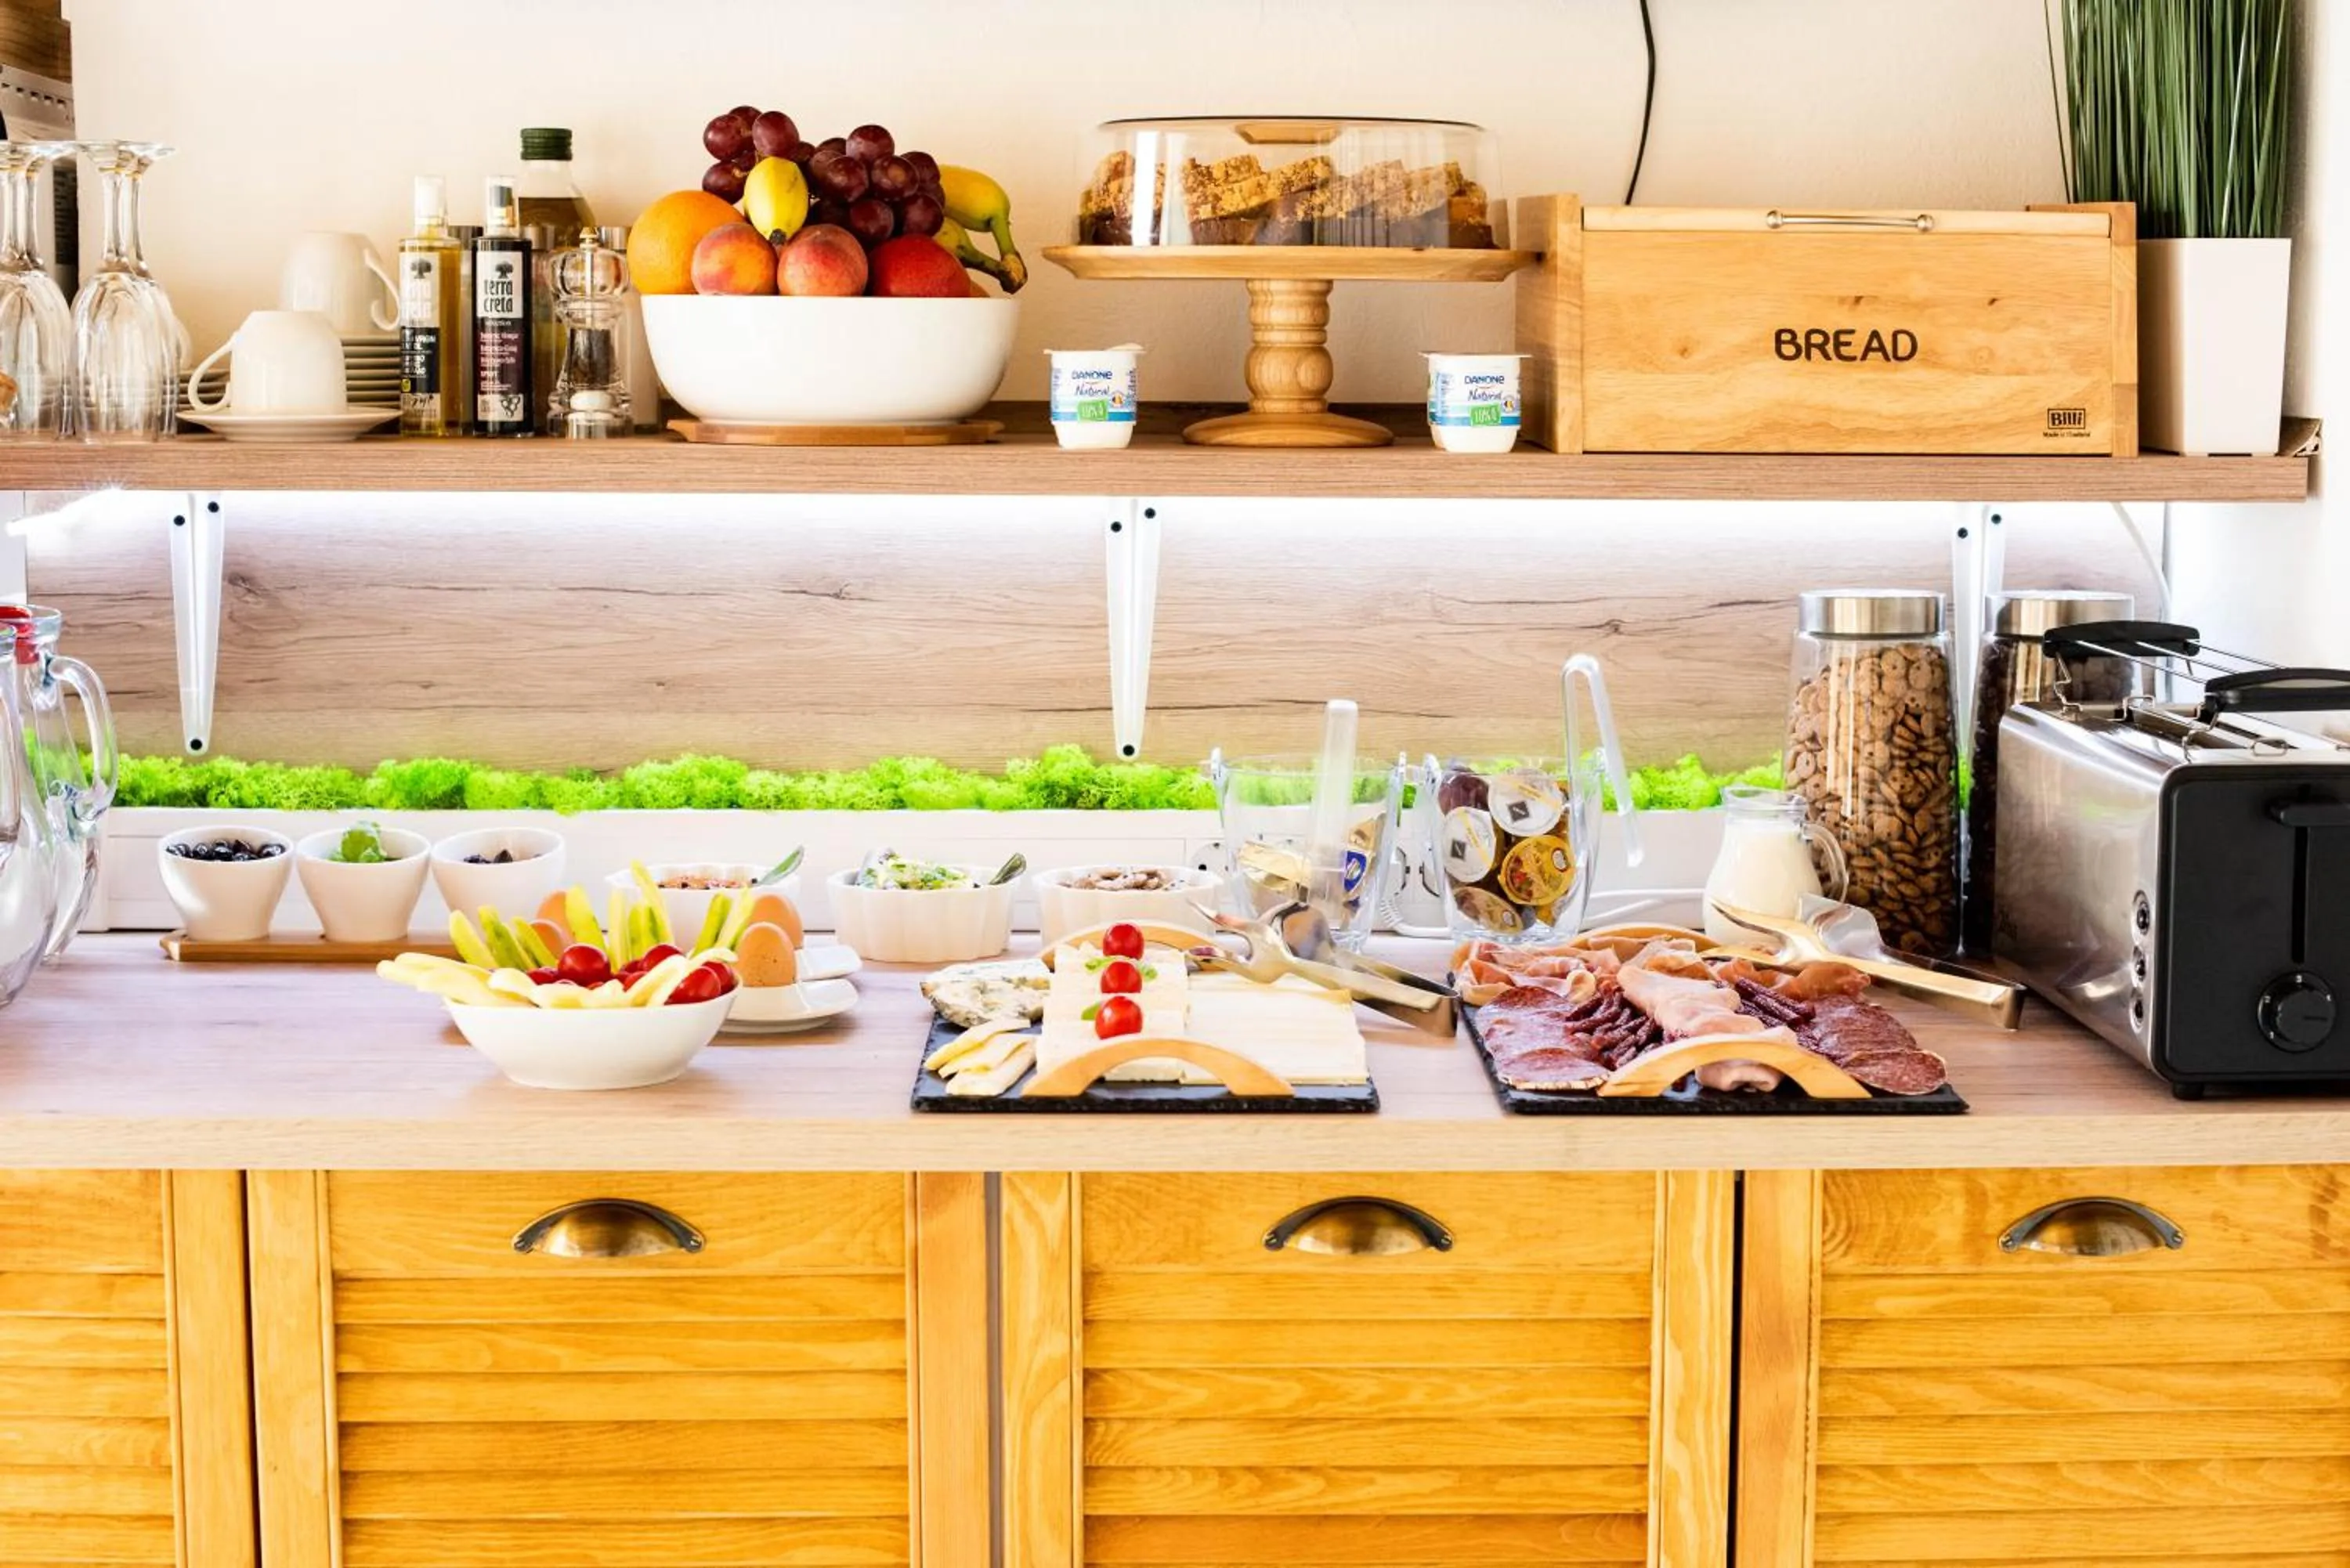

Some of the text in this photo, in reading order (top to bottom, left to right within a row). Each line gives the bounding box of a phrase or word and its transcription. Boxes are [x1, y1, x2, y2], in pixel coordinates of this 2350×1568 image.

[484, 280, 513, 295] terra
[484, 297, 513, 313] creta
[1774, 328, 1918, 362] BREAD
